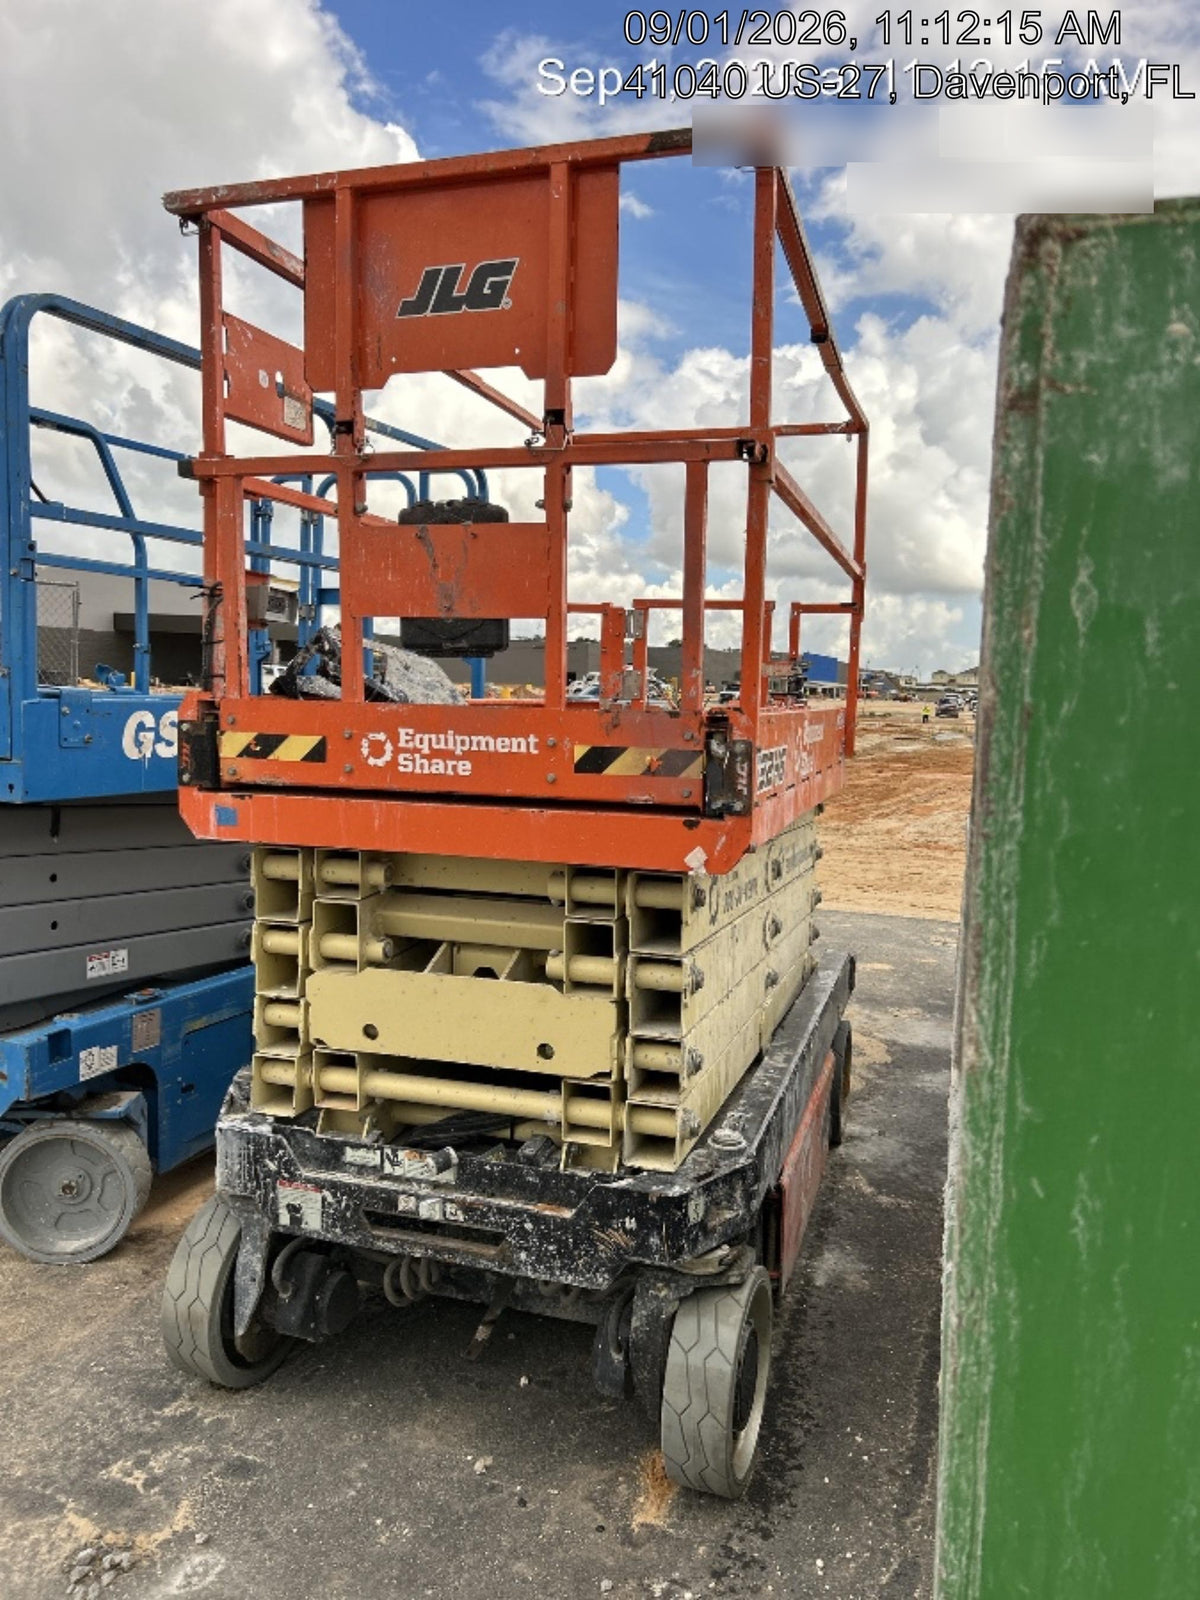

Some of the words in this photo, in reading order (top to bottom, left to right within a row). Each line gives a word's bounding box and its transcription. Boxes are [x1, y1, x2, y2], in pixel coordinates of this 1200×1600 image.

[395, 257, 519, 318] JLG
[398, 728, 540, 755] Equipment
[398, 752, 473, 776] Share
